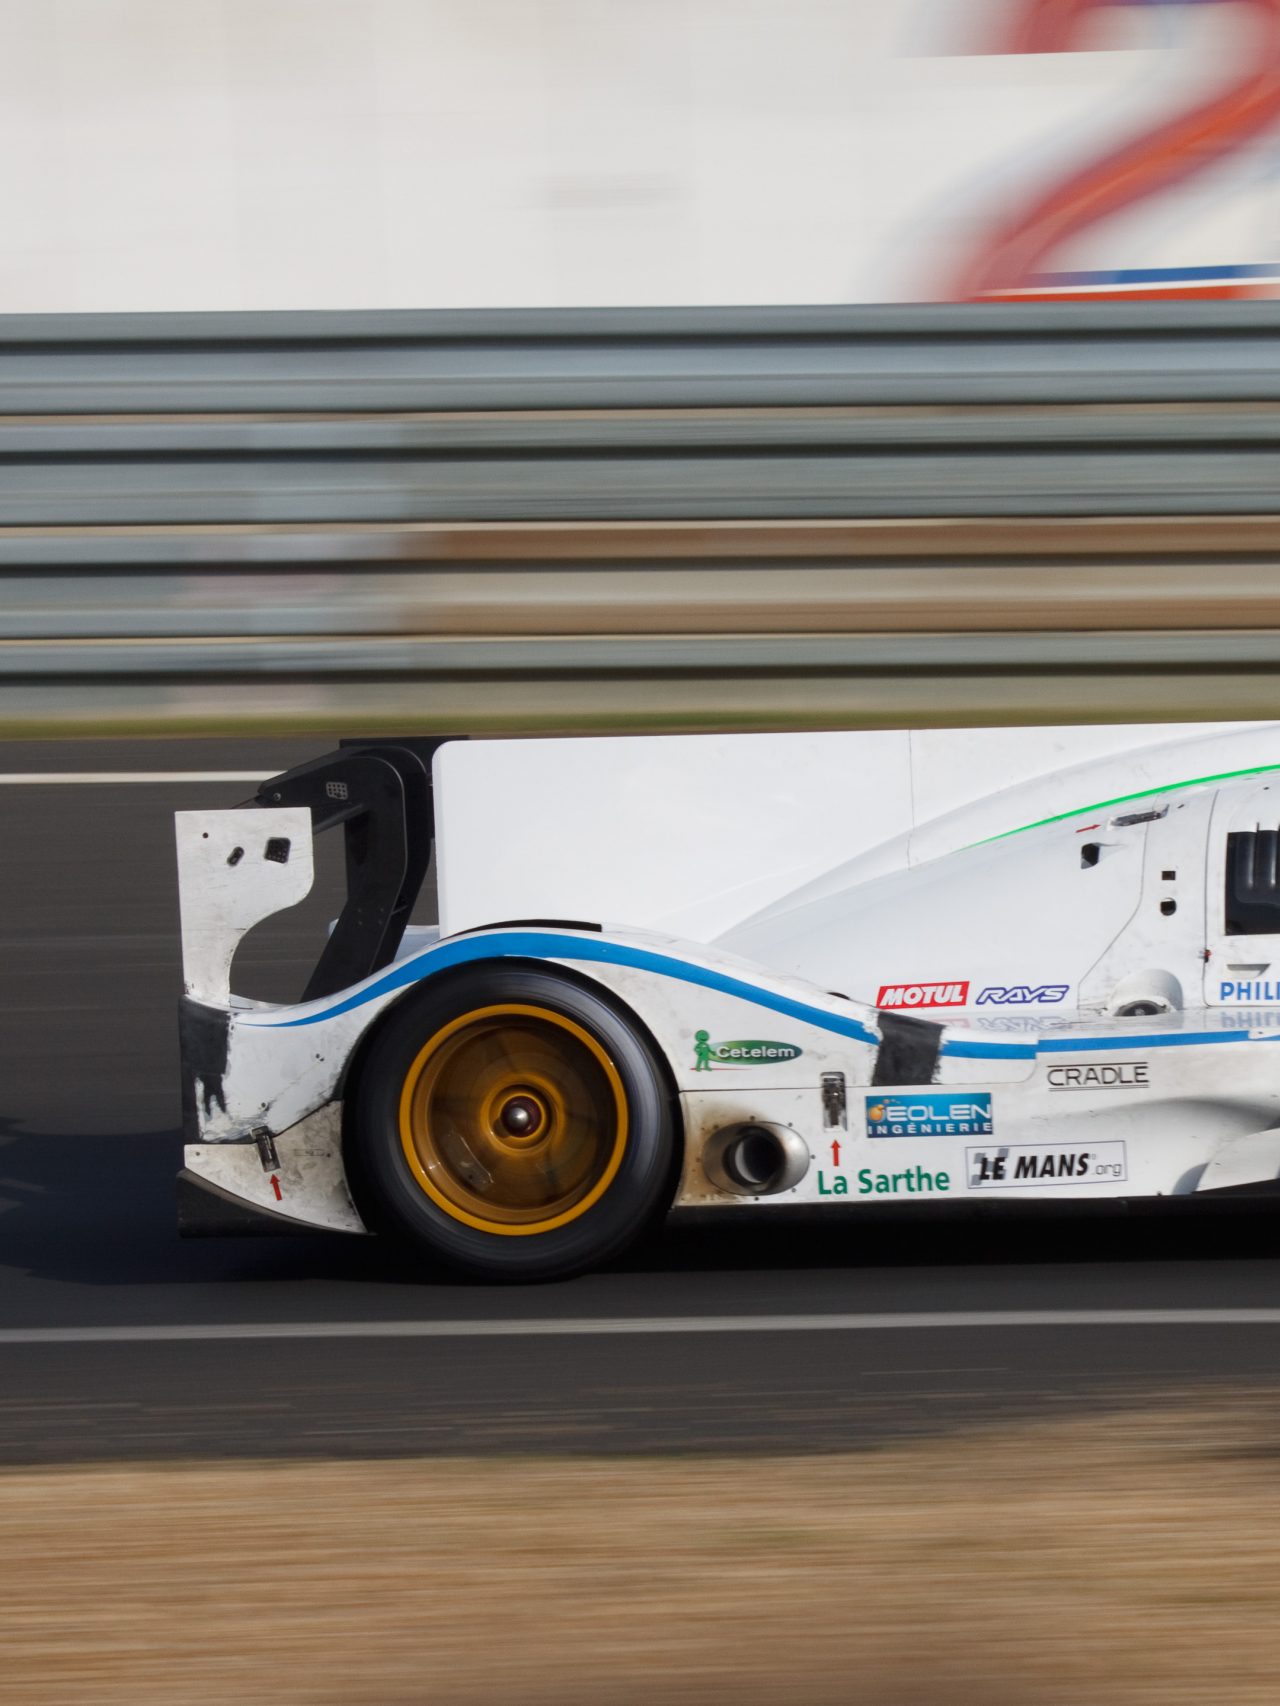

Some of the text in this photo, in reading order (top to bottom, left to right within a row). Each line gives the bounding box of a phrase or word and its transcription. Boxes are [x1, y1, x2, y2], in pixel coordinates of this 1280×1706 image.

[879, 984, 965, 1007] MOTUL
[975, 984, 1070, 1006] RAYS
[716, 1046, 795, 1058] Cetelem
[1047, 1065, 1150, 1087] CRADLE
[867, 1122, 993, 1135] INGÉNIERIE
[979, 1156, 1007, 1181] LE
[1014, 1153, 1090, 1179] MANS
[817, 1165, 951, 1195] La Sarthe
